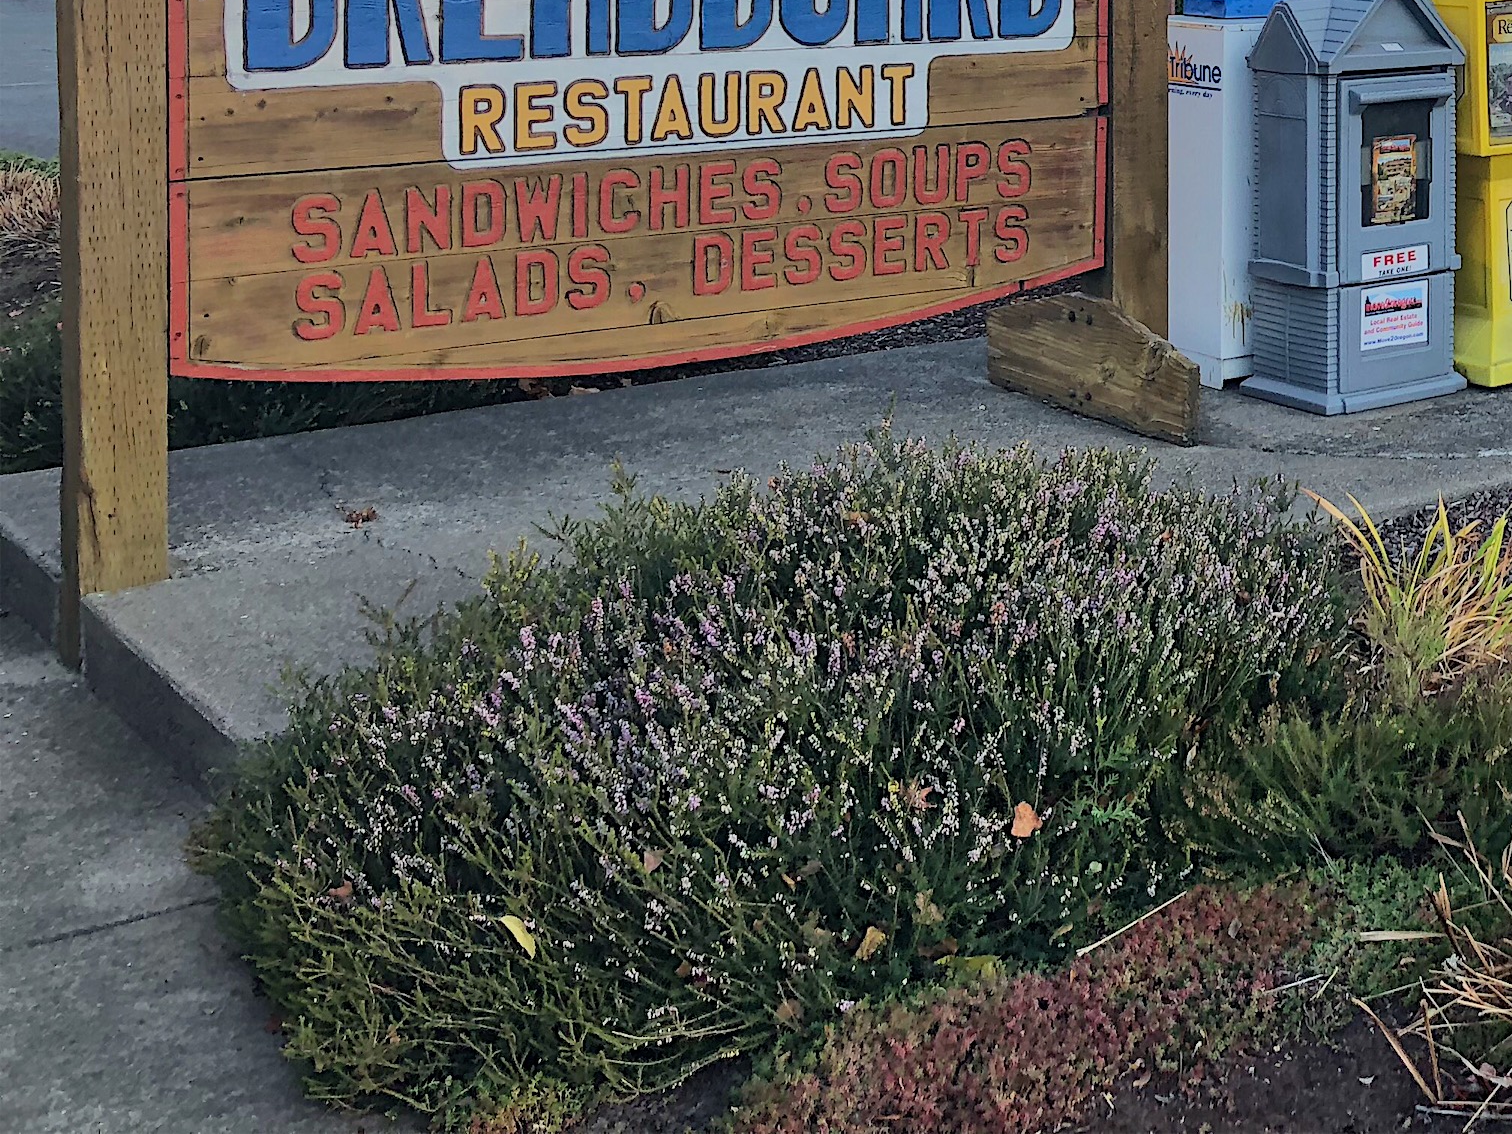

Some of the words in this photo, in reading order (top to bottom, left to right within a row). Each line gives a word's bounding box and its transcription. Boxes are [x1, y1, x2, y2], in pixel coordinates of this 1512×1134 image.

[1170, 56, 1222, 83] Tribune
[459, 63, 914, 155] RESTAURANT
[824, 138, 1032, 213] SOUPS
[692, 204, 1029, 296] DESSERTS
[1373, 250, 1416, 267] FREE
[1379, 269, 1394, 277] TAKE
[1370, 317, 1385, 326] Local
[1386, 315, 1398, 323] Real
[1376, 323, 1406, 333] Community
[1407, 320, 1423, 328] Guide
[1364, 332, 1423, 345] www.Move2Oregon.com
